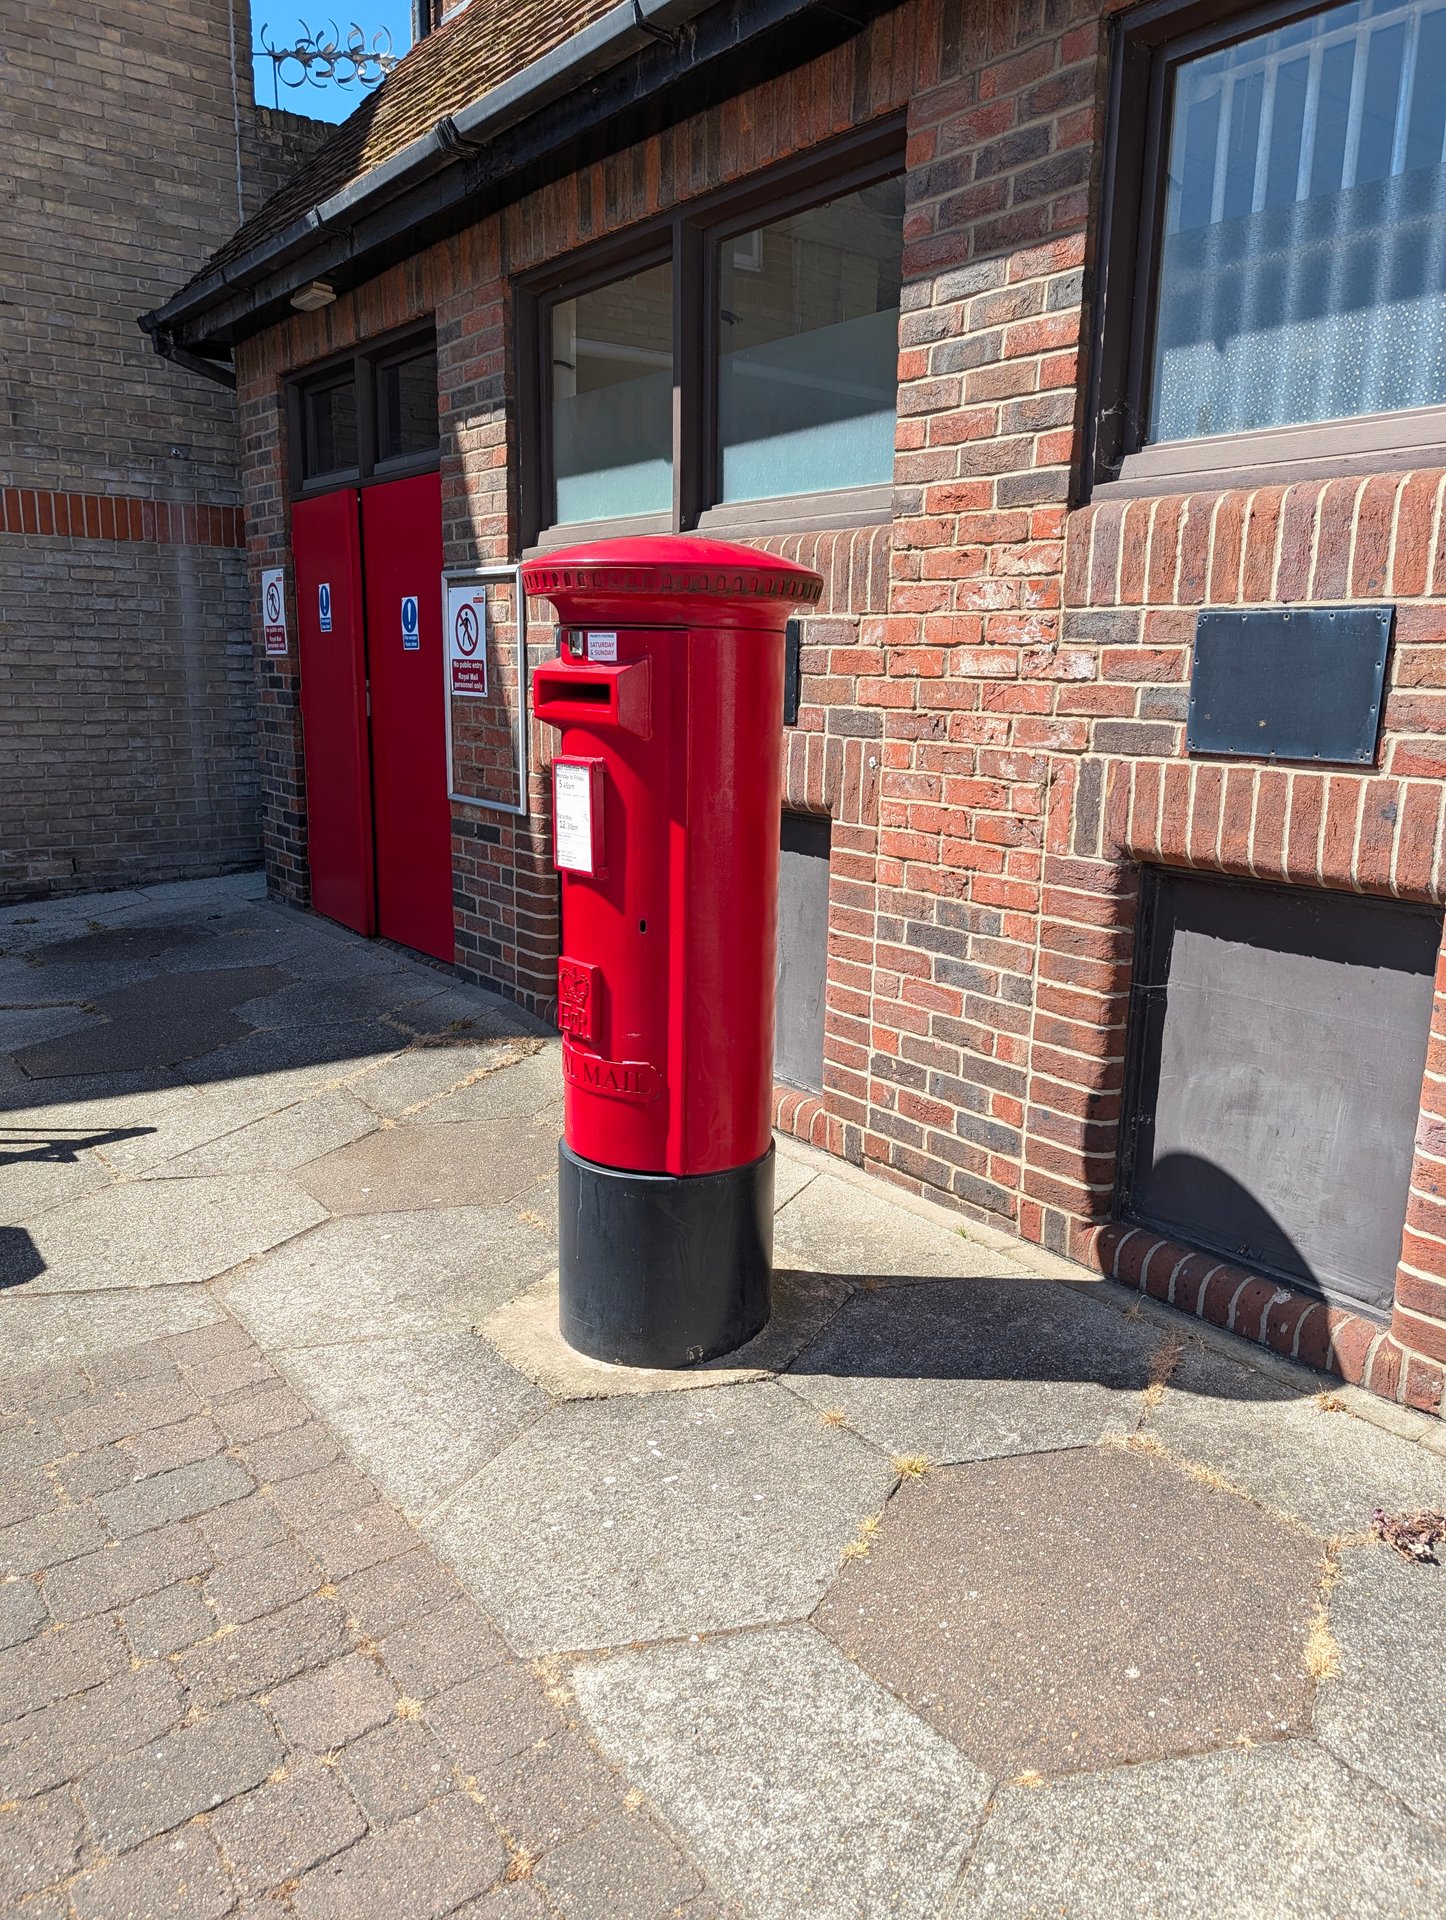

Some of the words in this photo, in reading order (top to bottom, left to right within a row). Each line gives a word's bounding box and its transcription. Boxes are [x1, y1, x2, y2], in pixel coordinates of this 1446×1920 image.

[460, 661, 471, 669] public
[472, 662, 482, 670] entry
[458, 672, 469, 681] Royal
[474, 682, 482, 691] only
[583, 1063, 652, 1094] MAIL
